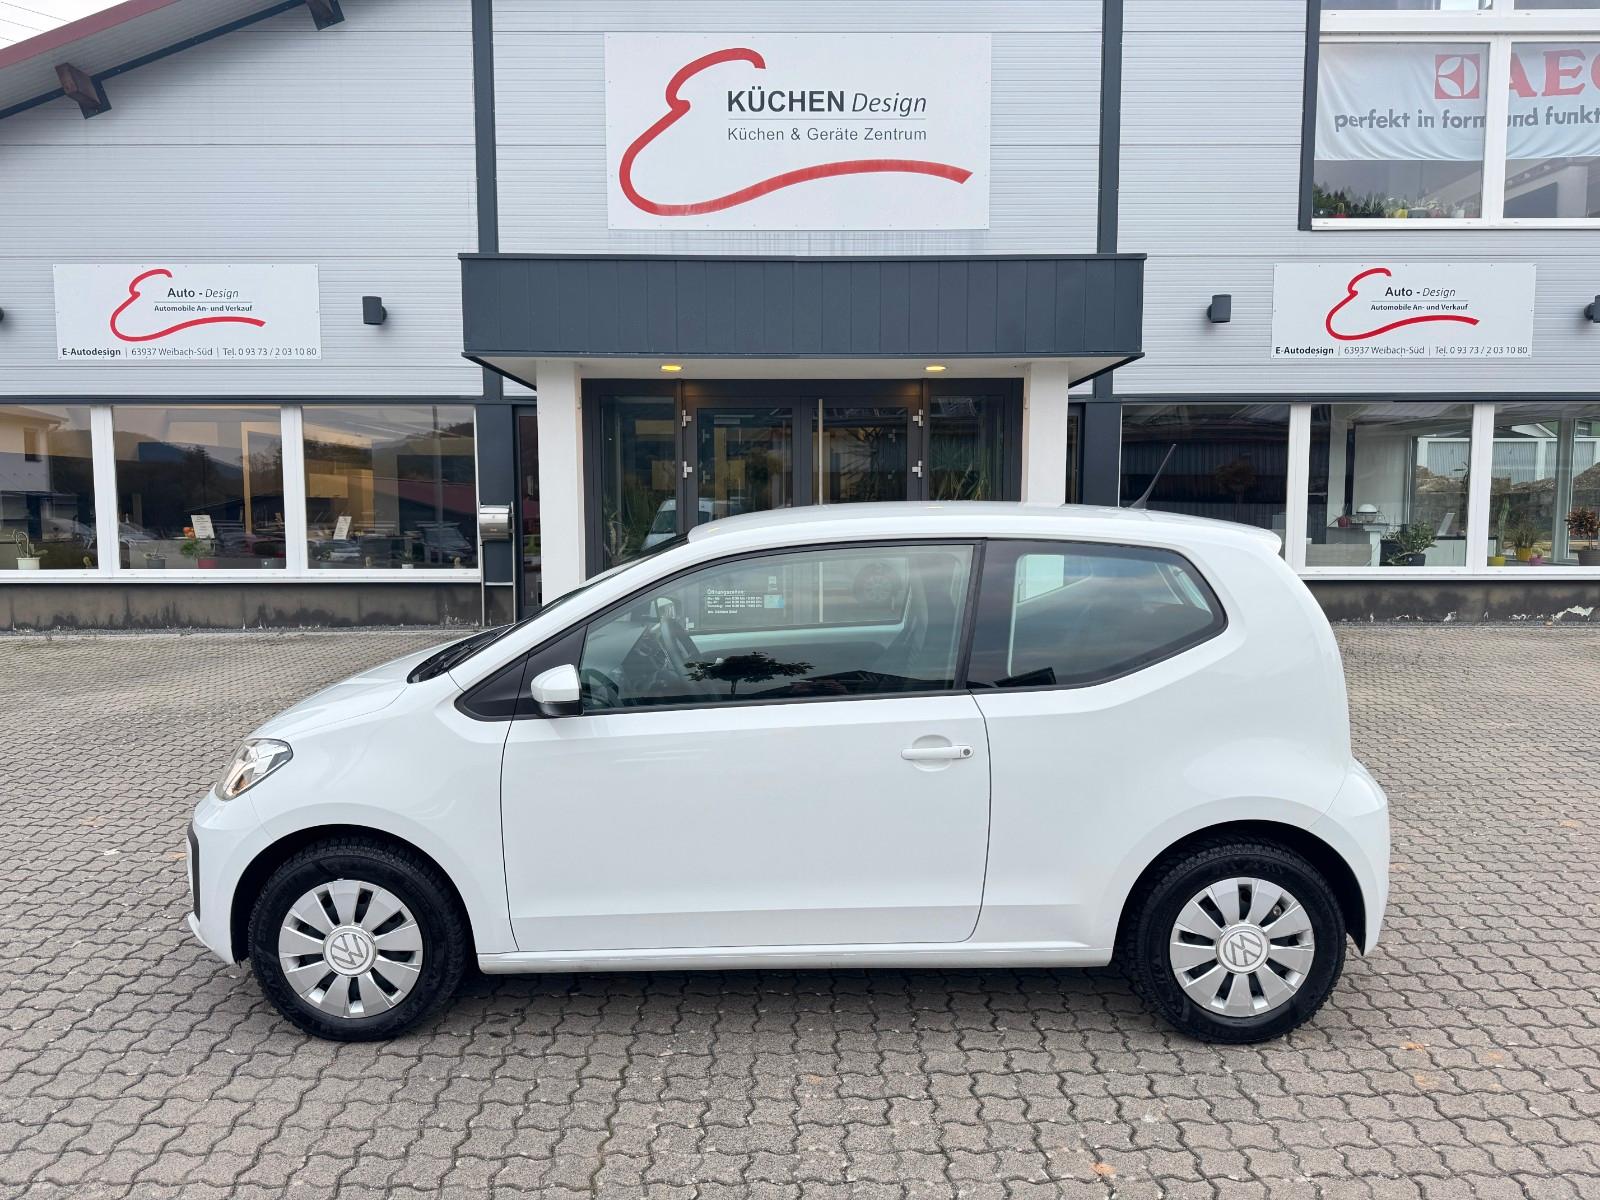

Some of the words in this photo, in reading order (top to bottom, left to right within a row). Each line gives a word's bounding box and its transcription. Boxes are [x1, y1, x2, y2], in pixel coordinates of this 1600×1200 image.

[1508, 49, 1600, 98] AE
[727, 86, 845, 113] KÜCHEN
[851, 92, 927, 118] Design
[1334, 108, 1411, 132] perfekt
[1417, 109, 1435, 128] in
[727, 127, 784, 141] Küchen
[790, 127, 801, 141] &
[807, 127, 858, 141] Geräte
[863, 127, 927, 141] Zentrum
[167, 287, 195, 298] Auto
[205, 288, 239, 299] Design
[1385, 286, 1413, 297] Auto
[1422, 287, 1456, 298] Design
[154, 304, 196, 312] Automobile
[196, 304, 209, 312] An-
[210, 304, 224, 312] und
[225, 304, 253, 312] Verkauf
[1370, 303, 1411, 311] Automobile
[1412, 303, 1425, 311] An-
[1426, 303, 1440, 311] und
[1441, 303, 1468, 311] Verkauf
[62, 347, 121, 357] E-Autodesign
[131, 347, 157, 356] 63937
[223, 347, 236, 356] Tel.
[245, 347, 256, 356] 93
[258, 347, 268, 356] 73
[282, 347, 292, 356] 03
[306, 347, 317, 356] 80
[1275, 346, 1334, 356] E-Autodesign
[1344, 346, 1370, 354] 63937
[1435, 346, 1448, 354] Tel.
[1457, 346, 1467, 354] 93
[1470, 346, 1479, 354] 73
[1493, 346, 1504, 354] 03
[1517, 346, 1528, 354] 80
